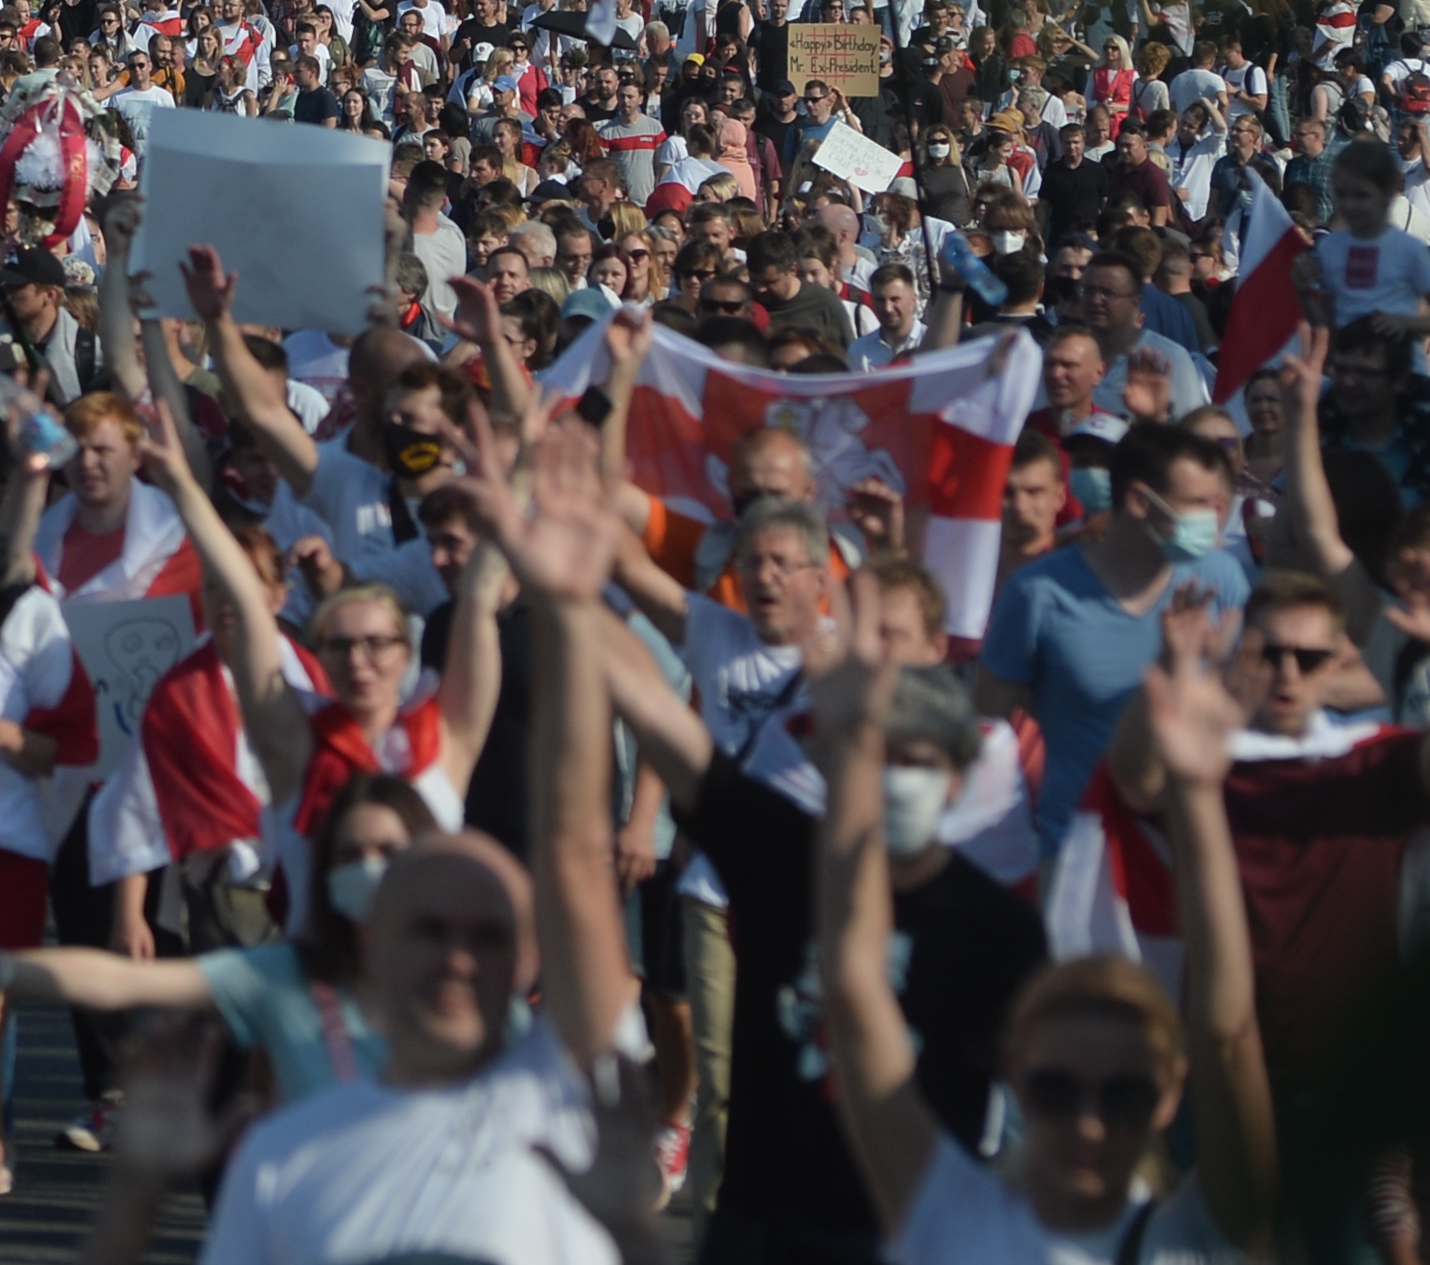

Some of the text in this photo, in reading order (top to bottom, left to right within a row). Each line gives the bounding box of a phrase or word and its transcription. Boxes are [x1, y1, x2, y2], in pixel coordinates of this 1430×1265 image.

[833, 35, 878, 56] Birthday
[790, 56, 877, 74] Mr. Ex-President
